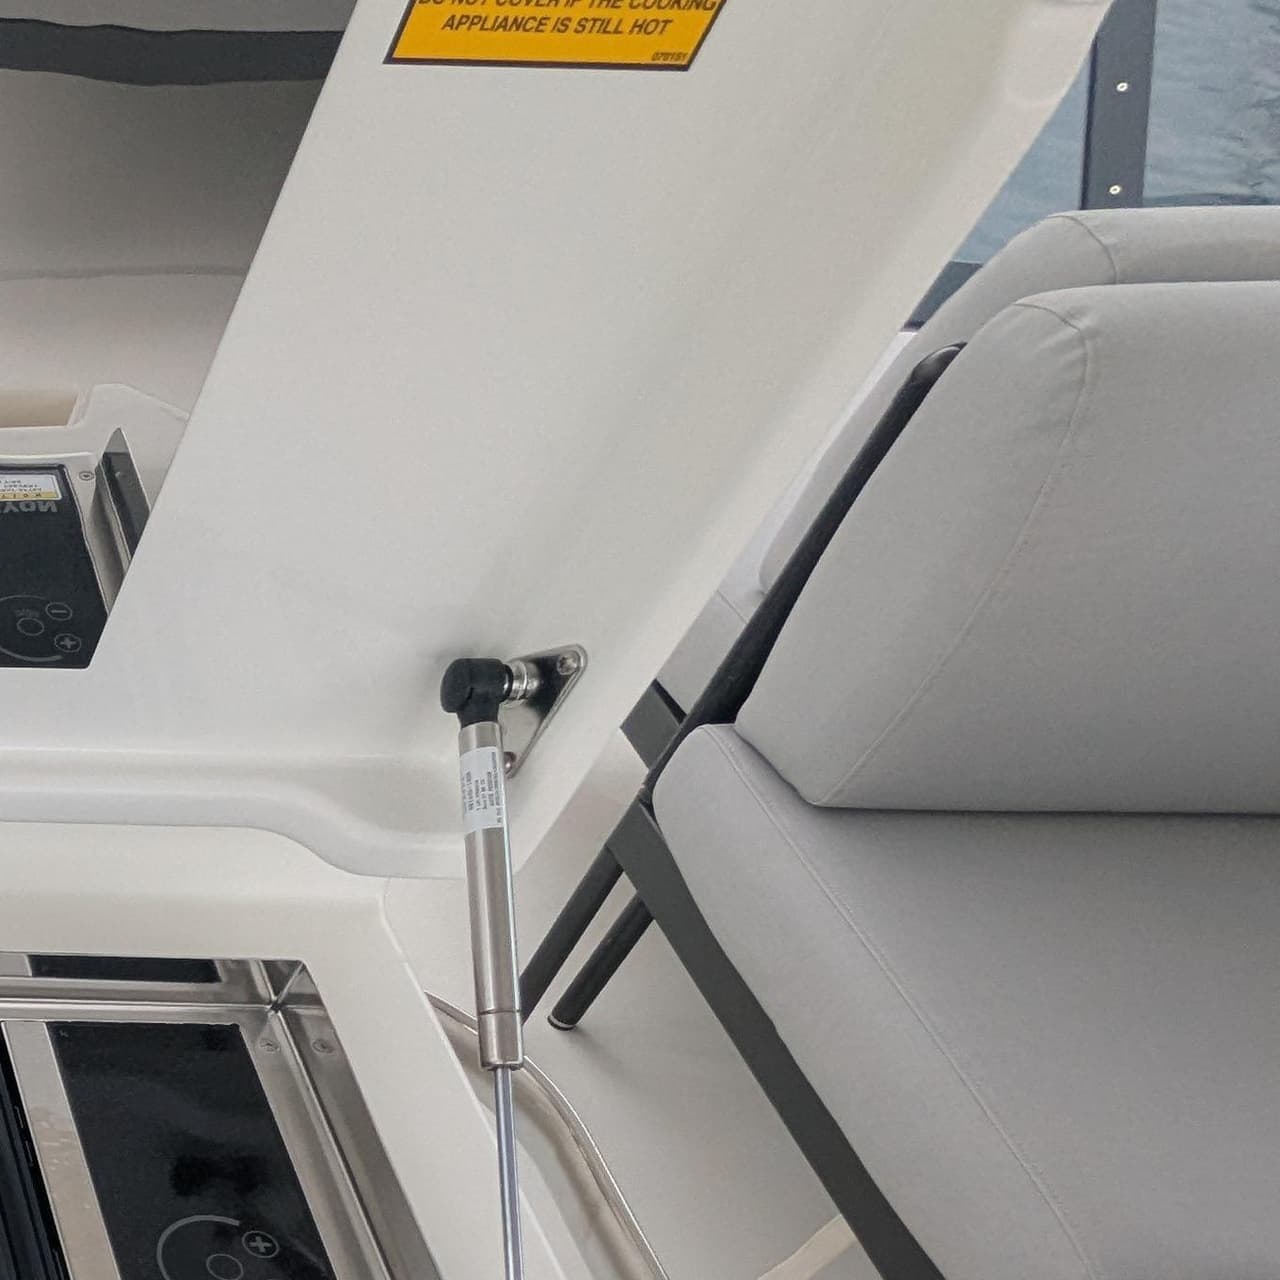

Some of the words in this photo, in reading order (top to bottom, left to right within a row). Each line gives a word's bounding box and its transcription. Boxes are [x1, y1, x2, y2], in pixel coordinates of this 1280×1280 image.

[441, 14, 550, 33] APPLIANCE
[550, 16, 572, 34] IS
[573, 17, 624, 35] STILL
[628, 18, 674, 36] HOT
